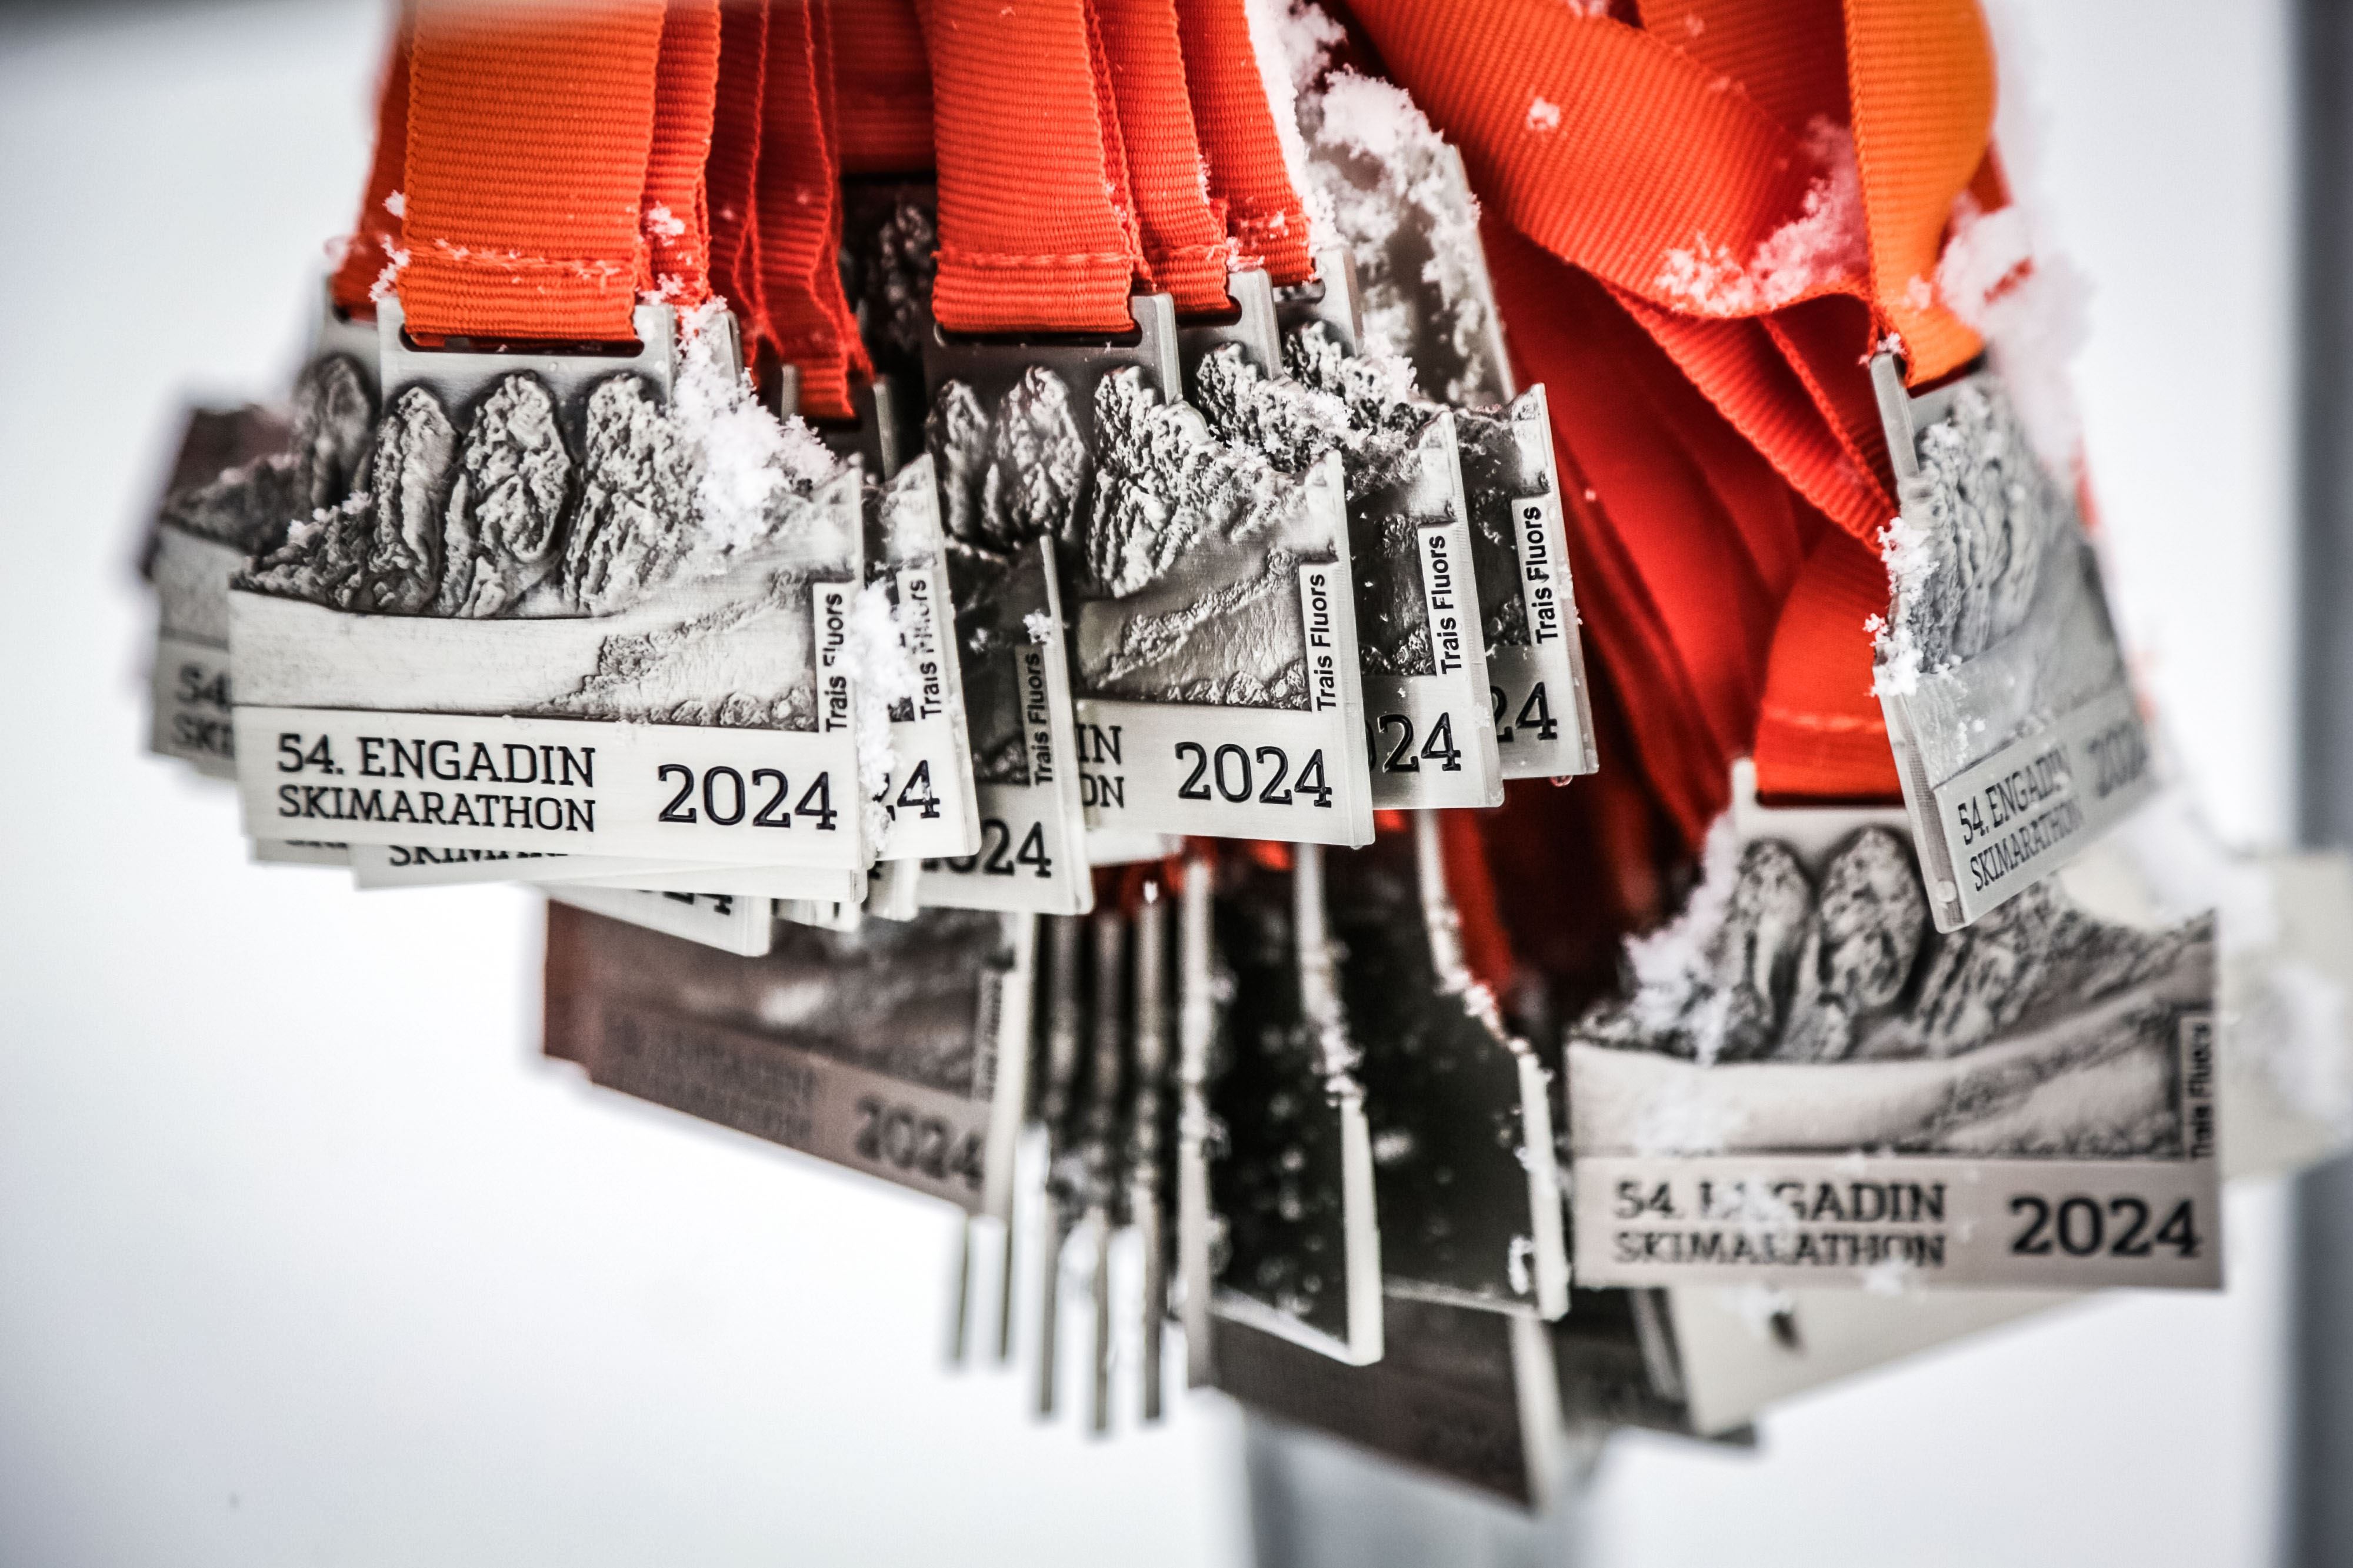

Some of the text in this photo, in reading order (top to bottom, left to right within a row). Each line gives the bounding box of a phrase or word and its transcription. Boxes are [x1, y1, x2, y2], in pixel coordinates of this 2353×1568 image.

[1428, 535, 1464, 675] Trais Fluors
[1521, 505, 1559, 645] Trais Fluors
[1309, 573, 1338, 712] Trais Fluors
[825, 675, 848, 733] Trais
[921, 660, 942, 720] Trais
[1025, 652, 1054, 786] Trais Fluors
[278, 733, 595, 788] 54. ENGADIN
[1174, 742, 1333, 809] 2024
[277, 783, 595, 832] SKIMARATHON
[656, 763, 838, 831] 2024
[1958, 795, 1989, 845] 54.
[2009, 1196, 2205, 1259] 2024
